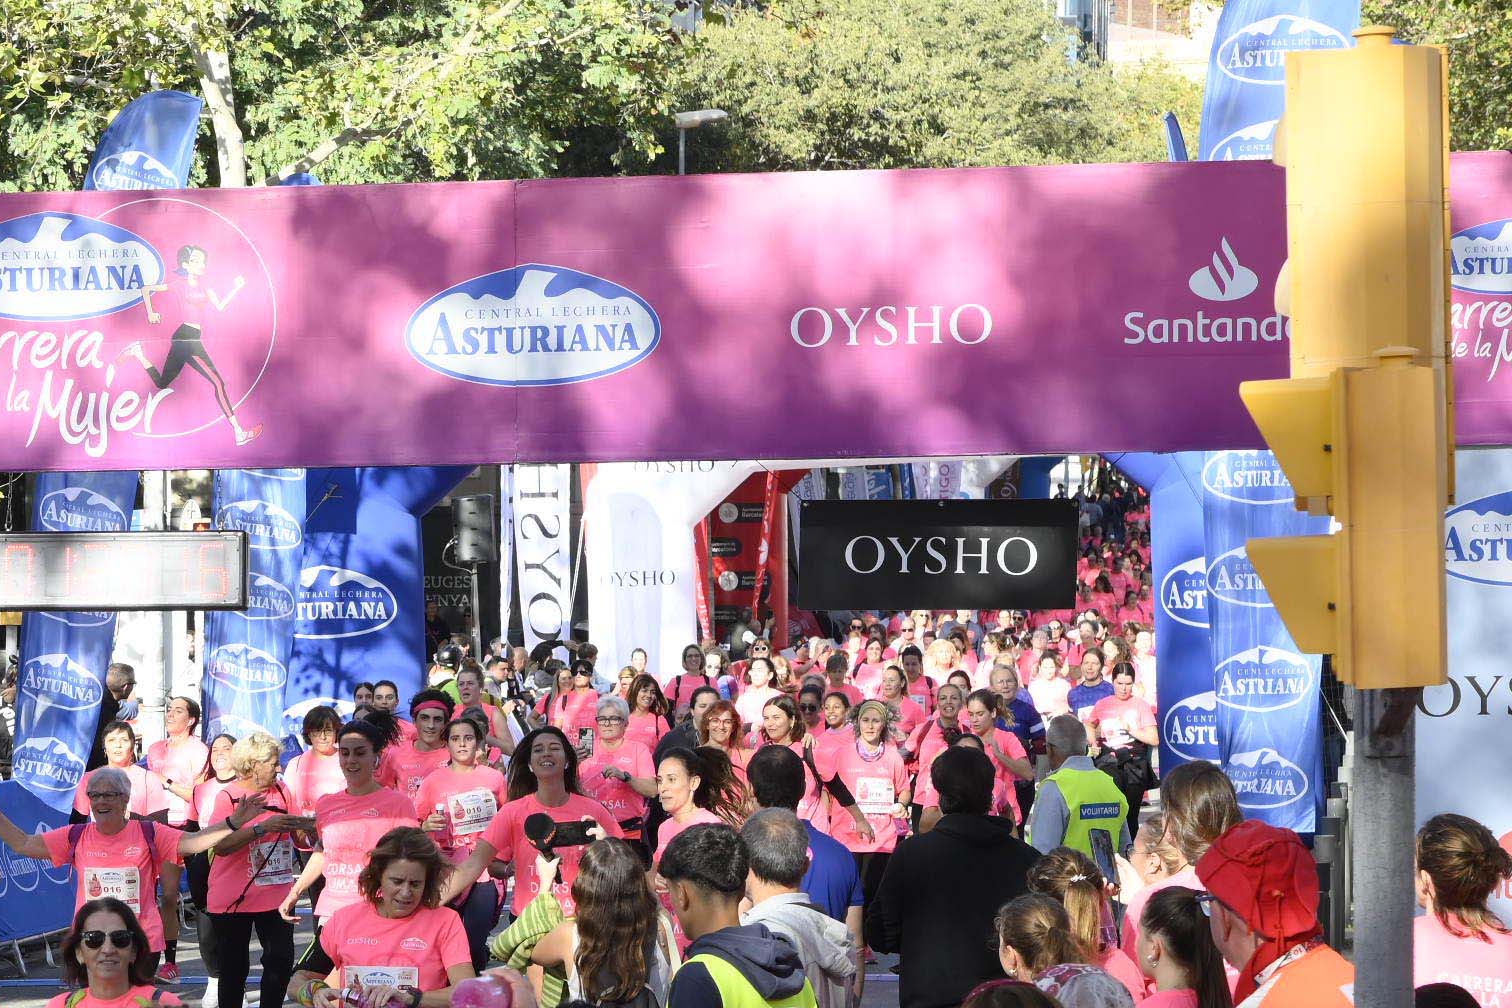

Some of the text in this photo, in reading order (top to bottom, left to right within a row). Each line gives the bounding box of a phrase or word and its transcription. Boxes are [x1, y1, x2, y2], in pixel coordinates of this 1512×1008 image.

[1246, 38, 1337, 47] CENTRAL LECHERA
[1227, 42, 1285, 69] ASTUR
[67, 246, 140, 260] LECHERA
[1464, 245, 1511, 254] CENTRA
[464, 303, 632, 321] CENTRAL LECHERA
[1451, 300, 1512, 330] arre
[424, 311, 641, 357] ASTURIANA
[789, 303, 993, 349] OYSHO
[1474, 328, 1492, 358] la
[7, 378, 31, 412] la
[25, 365, 175, 458] Mujer
[1212, 462, 1292, 488] ASTURIA
[43, 499, 122, 531] ASURIANA
[1471, 523, 1512, 533] CENT
[519, 463, 563, 641] OYSH
[844, 535, 1039, 576] OYSHO
[600, 569, 677, 587] OYSHO
[248, 594, 290, 613] RIANA
[299, 589, 383, 599] NTRAL LECHERA
[296, 600, 388, 621] TURIANA
[1217, 671, 1305, 696] ASTRIANA
[1416, 674, 1512, 718] OYS
[1186, 714, 1216, 723] CENT
[603, 799, 626, 810] SAL
[328, 878, 357, 889] UMA
[530, 882, 569, 894] DRS
